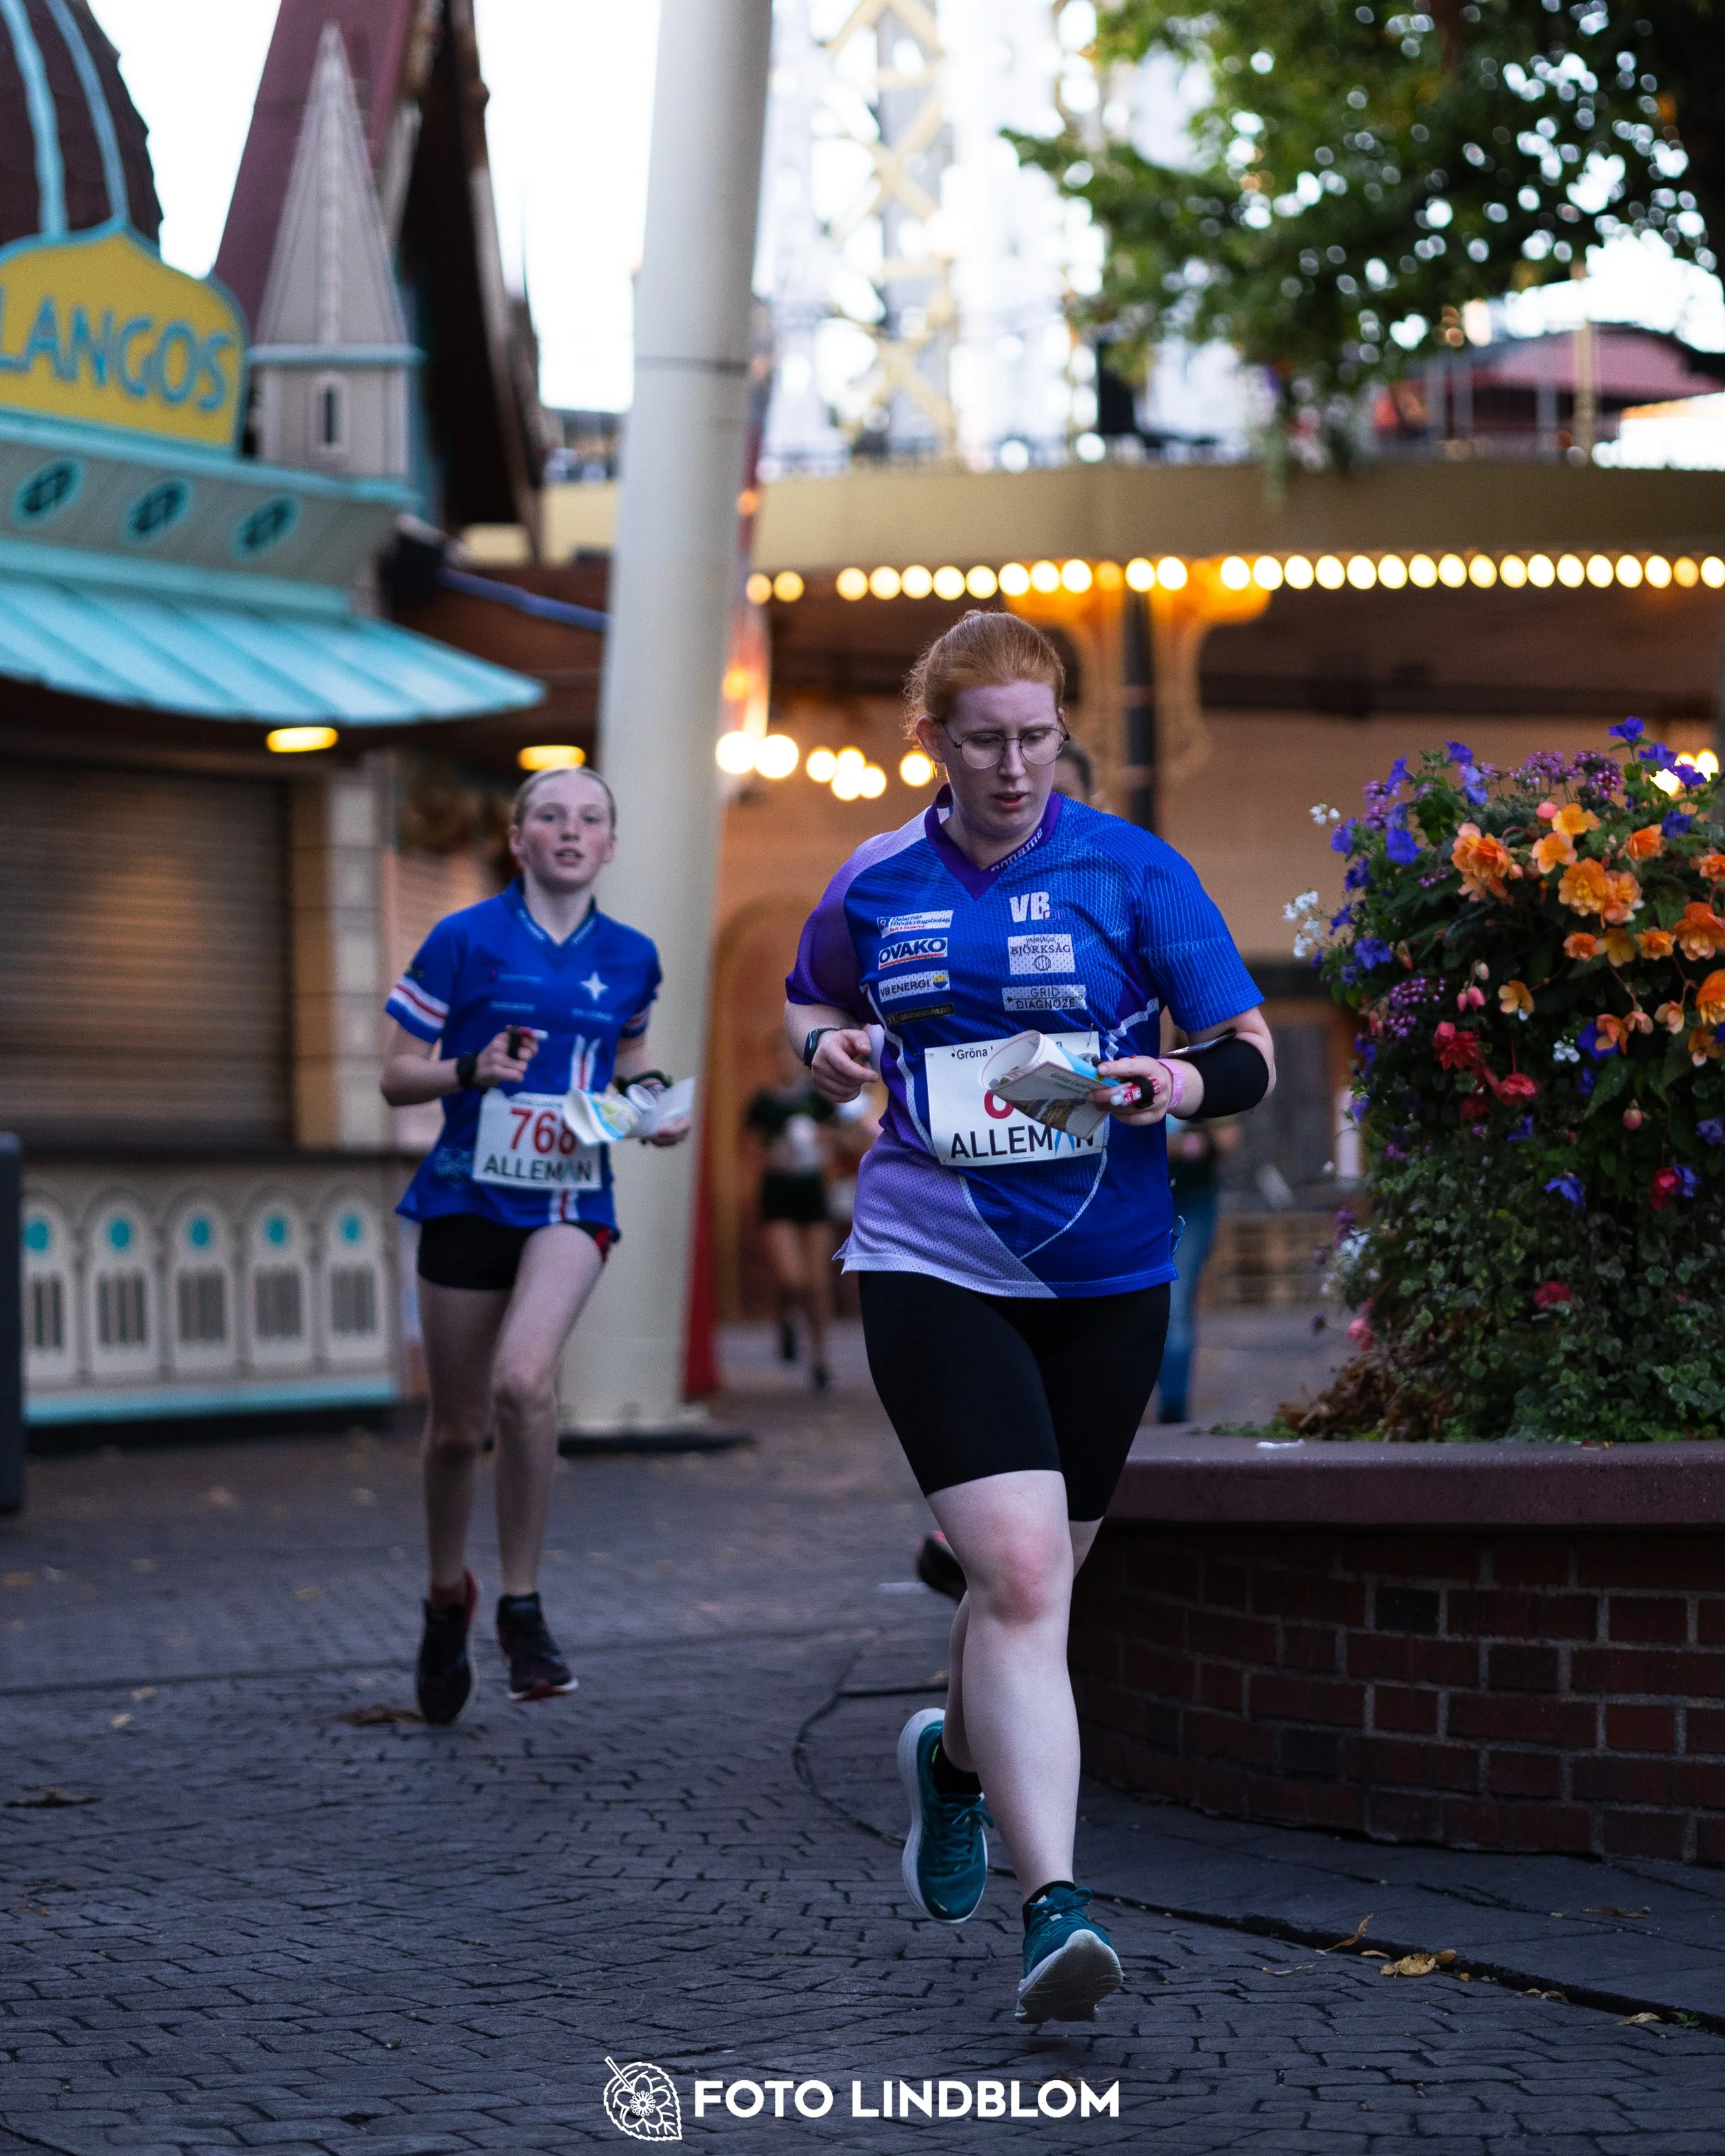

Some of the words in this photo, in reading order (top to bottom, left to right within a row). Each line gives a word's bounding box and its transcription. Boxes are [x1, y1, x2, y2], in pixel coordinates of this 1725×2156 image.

[1009, 891, 1050, 922] VB
[879, 938, 947, 964] OVAKO
[1010, 942, 1071, 956] BJÖRKSÅG
[1030, 987, 1060, 997] GRID
[956, 1048, 988, 1060] Gröna
